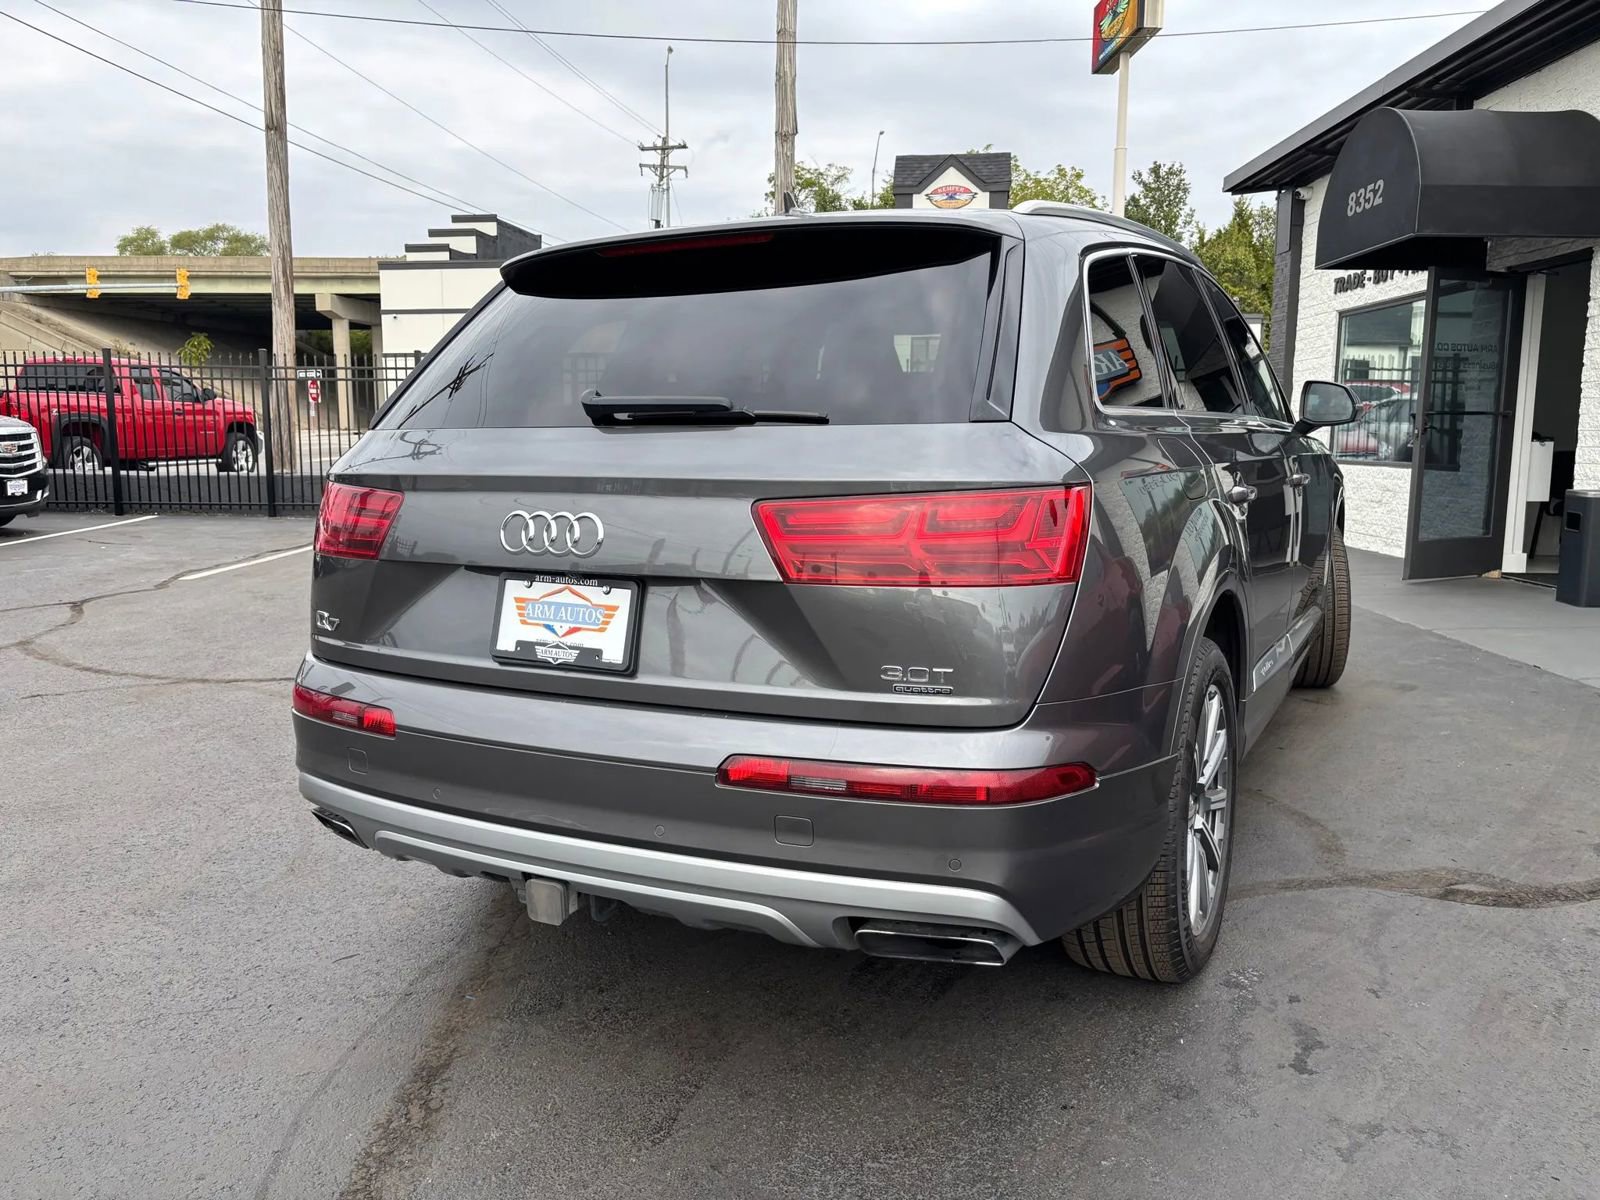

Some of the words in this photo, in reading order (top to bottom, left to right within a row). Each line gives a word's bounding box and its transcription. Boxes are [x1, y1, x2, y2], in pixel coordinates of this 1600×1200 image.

[1347, 179, 1384, 217] 8352
[1334, 270, 1366, 295] TRADE
[535, 575, 598, 586] arm-autos.com
[316, 610, 340, 631] Q7
[525, 602, 554, 619] ARM
[556, 605, 605, 624] AUTOS
[880, 665, 954, 683] 3.0T
[895, 686, 951, 694] quattro
